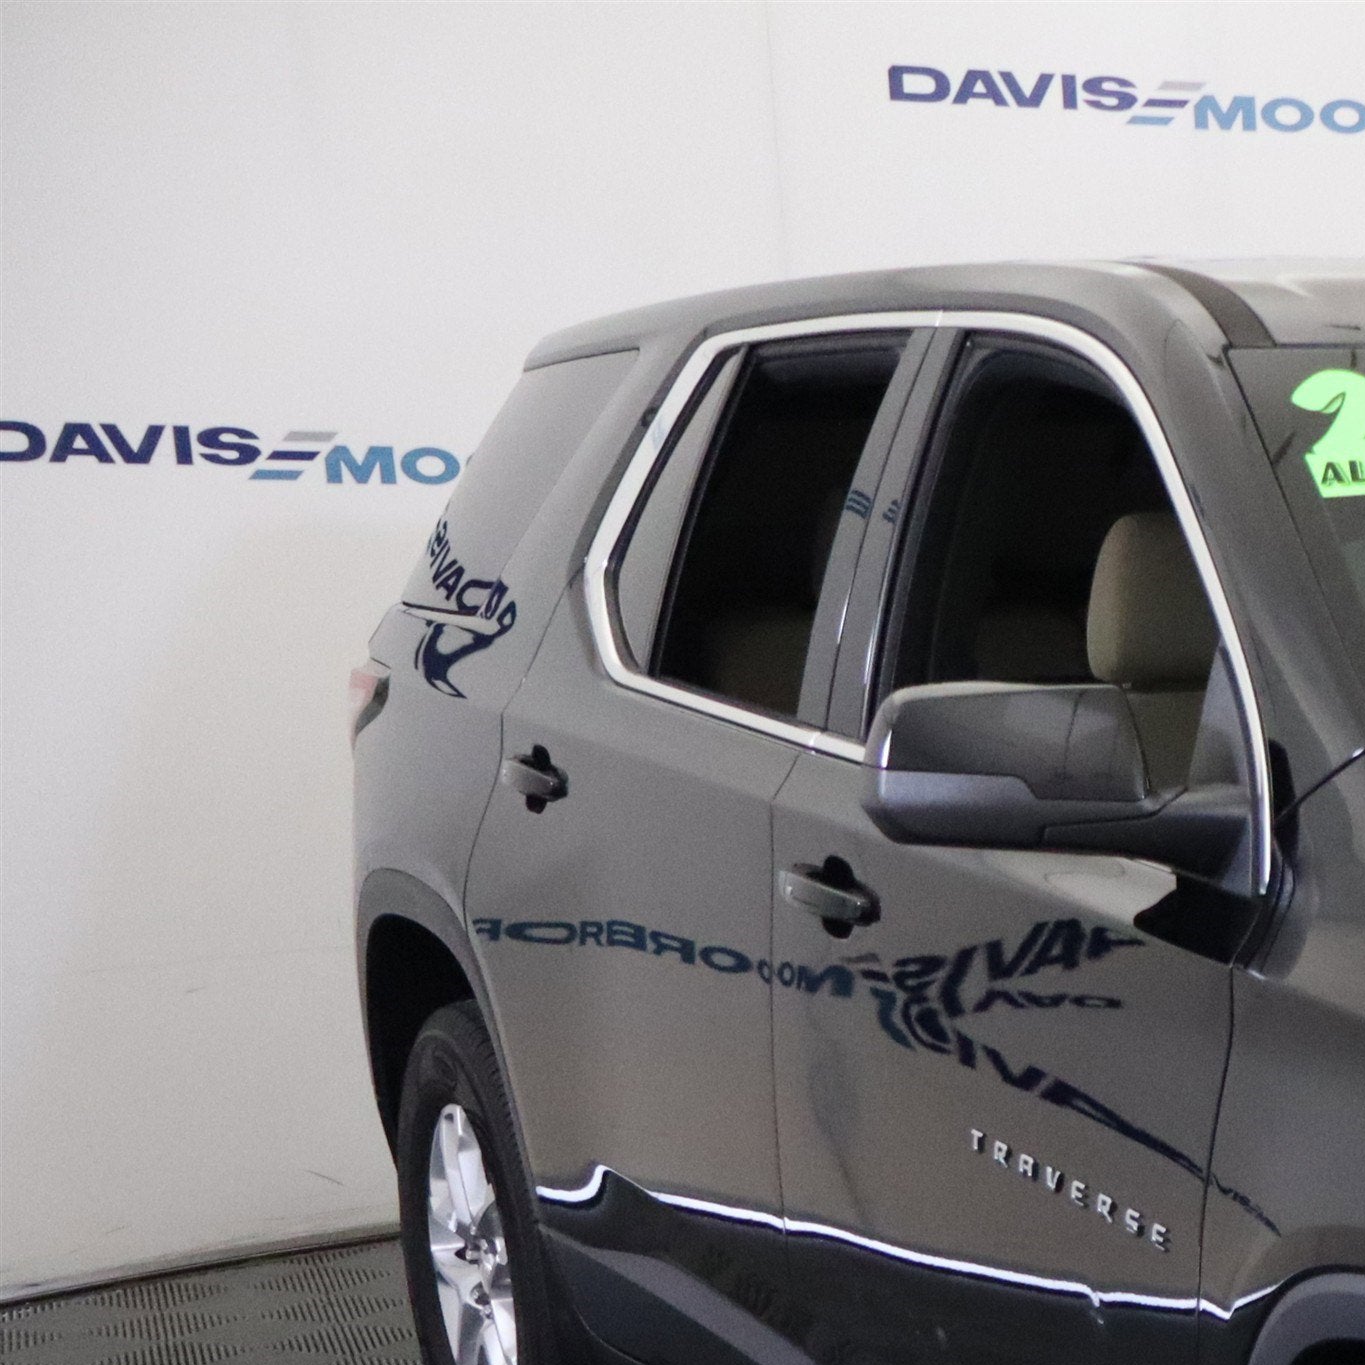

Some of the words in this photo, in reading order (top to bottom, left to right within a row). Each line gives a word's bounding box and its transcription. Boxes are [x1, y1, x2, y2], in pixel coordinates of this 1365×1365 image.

[888, 65, 1138, 111] DAVIS
[0, 421, 260, 466] DAVIS
[970, 1128, 1168, 1251] TRAVERSE
